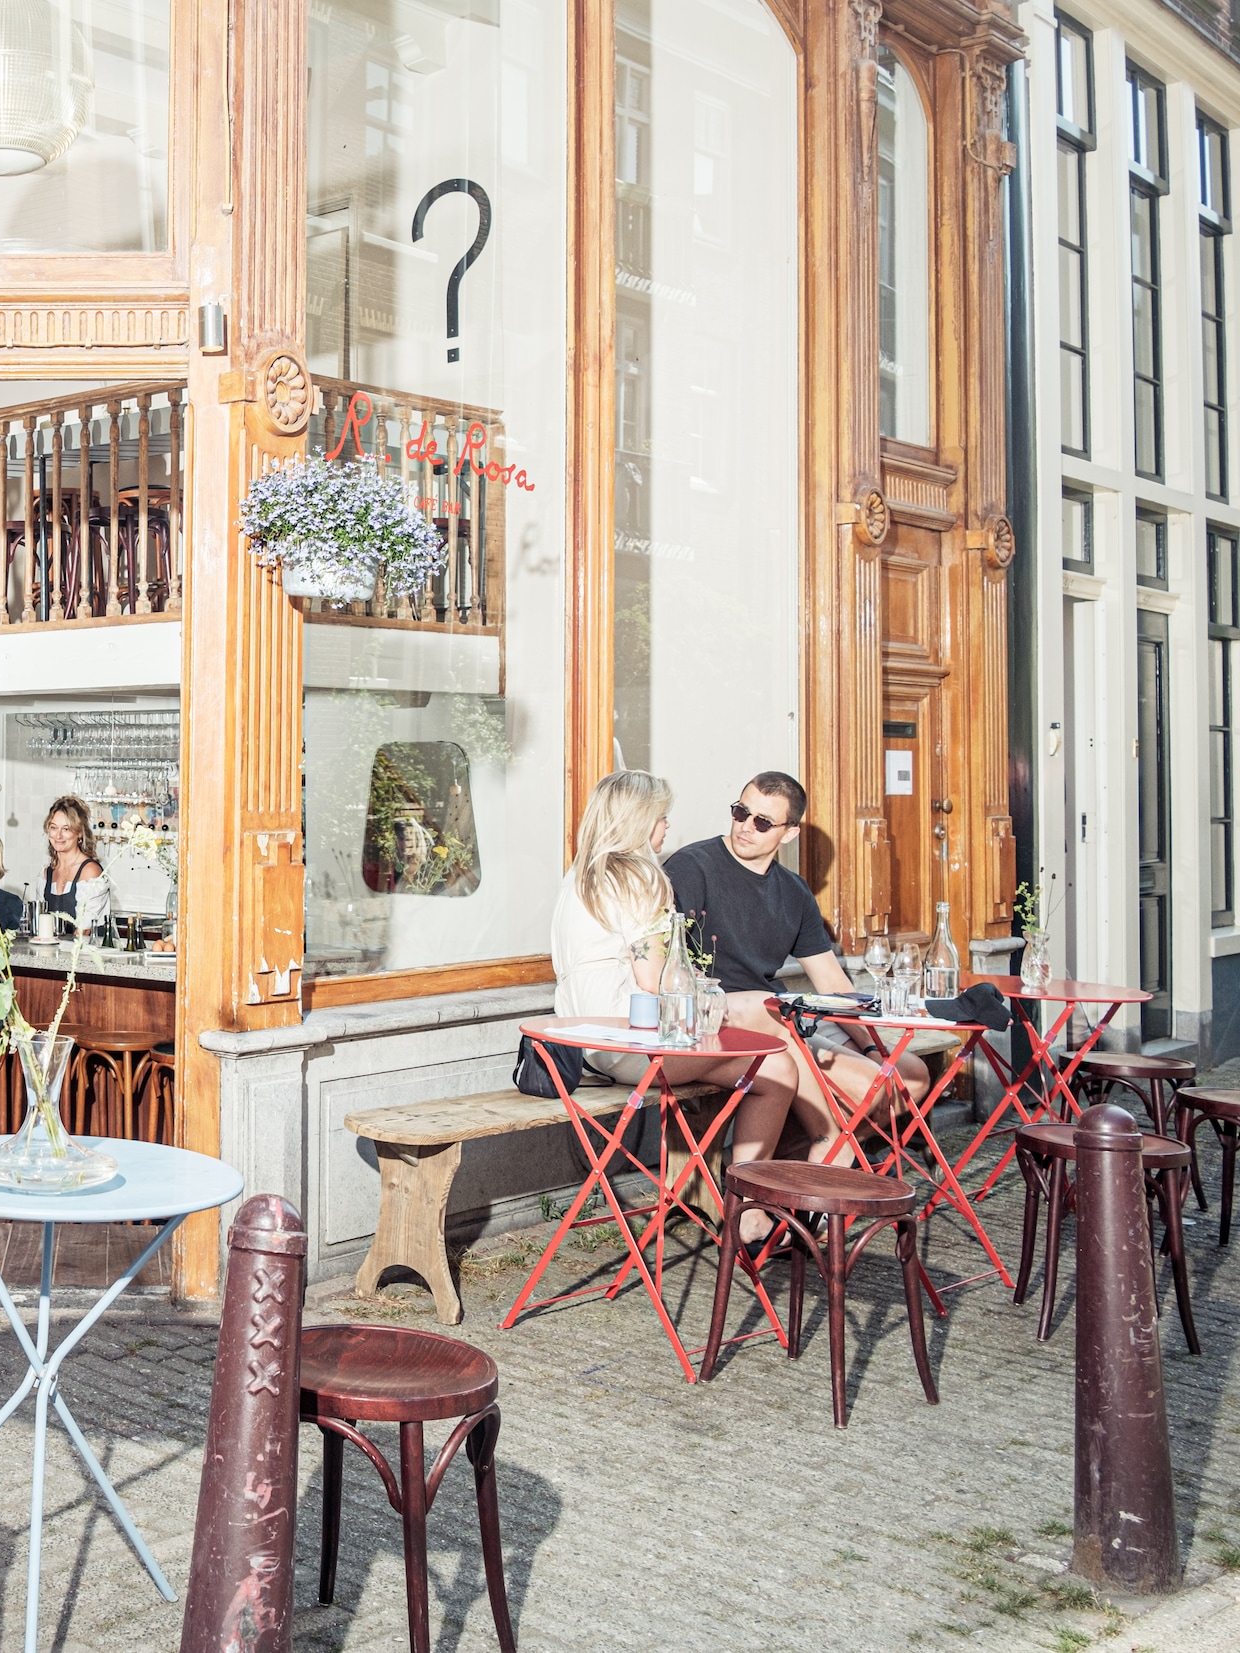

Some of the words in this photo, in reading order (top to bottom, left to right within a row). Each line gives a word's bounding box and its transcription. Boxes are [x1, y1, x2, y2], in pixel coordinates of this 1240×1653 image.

[325, 391, 391, 463] R.
[406, 420, 443, 465] de
[454, 423, 535, 491] Rosa
[414, 494, 438, 511] CAFÉ
[442, 499, 461, 515] BAR
